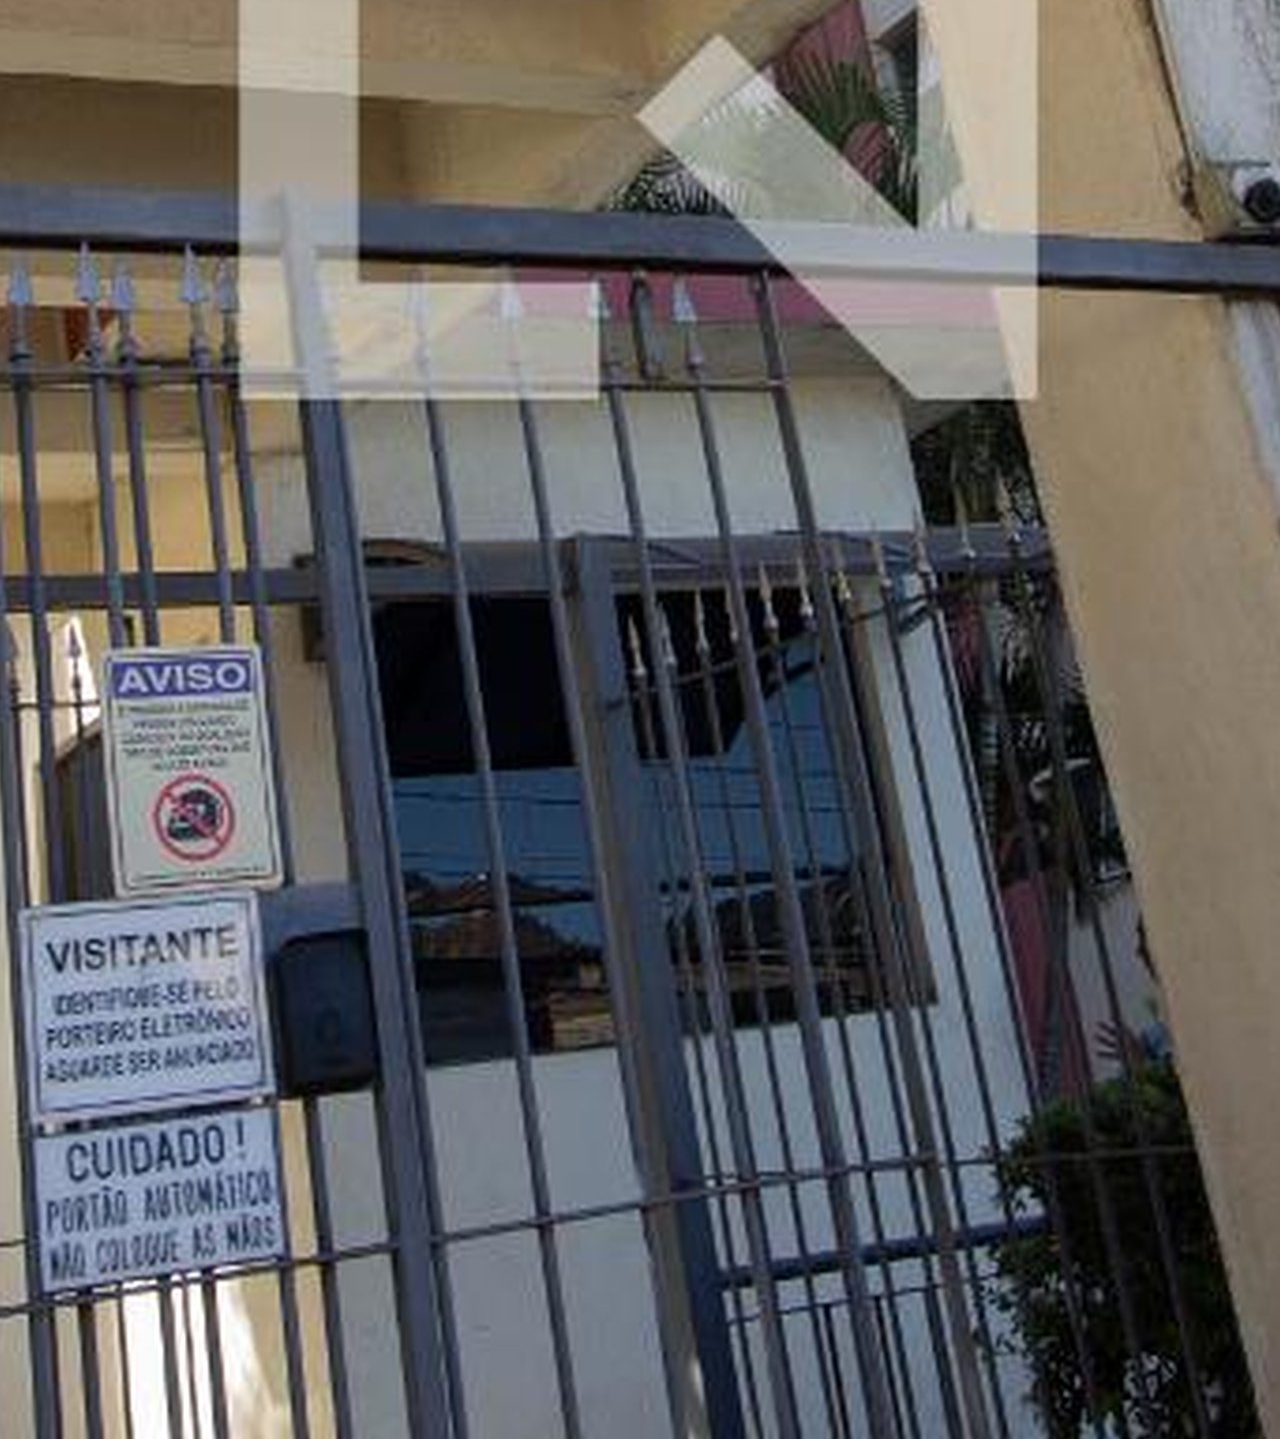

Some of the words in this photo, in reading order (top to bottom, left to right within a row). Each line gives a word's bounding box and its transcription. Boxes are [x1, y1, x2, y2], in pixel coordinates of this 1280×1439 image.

[118, 662, 247, 694] AVISO
[45, 924, 240, 973] VISITANTE
[45, 1020, 136, 1051] PORTEIRO
[128, 1049, 162, 1076] SER
[46, 1185, 128, 1236] PORTÃO
[143, 1168, 272, 1222] AUTOMÁTICO
[49, 1240, 87, 1281] NÃO
[96, 1230, 179, 1273] COLOQUE
[192, 1223, 217, 1260] AS
[226, 1212, 276, 1251] MÃOS
